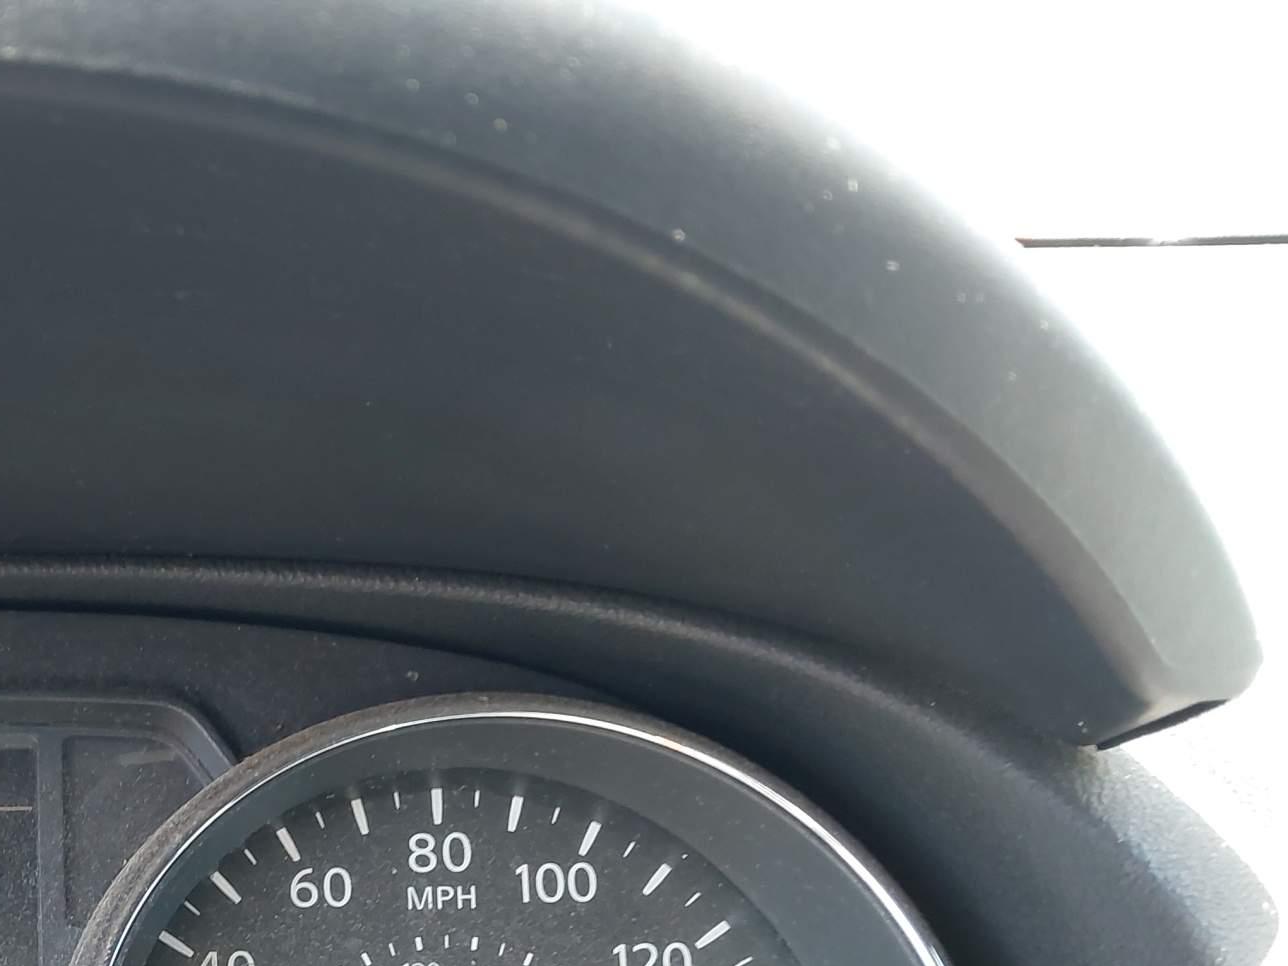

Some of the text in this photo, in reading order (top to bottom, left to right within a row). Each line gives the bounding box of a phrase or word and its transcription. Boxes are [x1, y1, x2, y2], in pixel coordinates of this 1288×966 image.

[408, 832, 472, 873] 80
[289, 868, 353, 908] 60
[406, 885, 478, 911] MPH
[515, 861, 598, 903] 100
